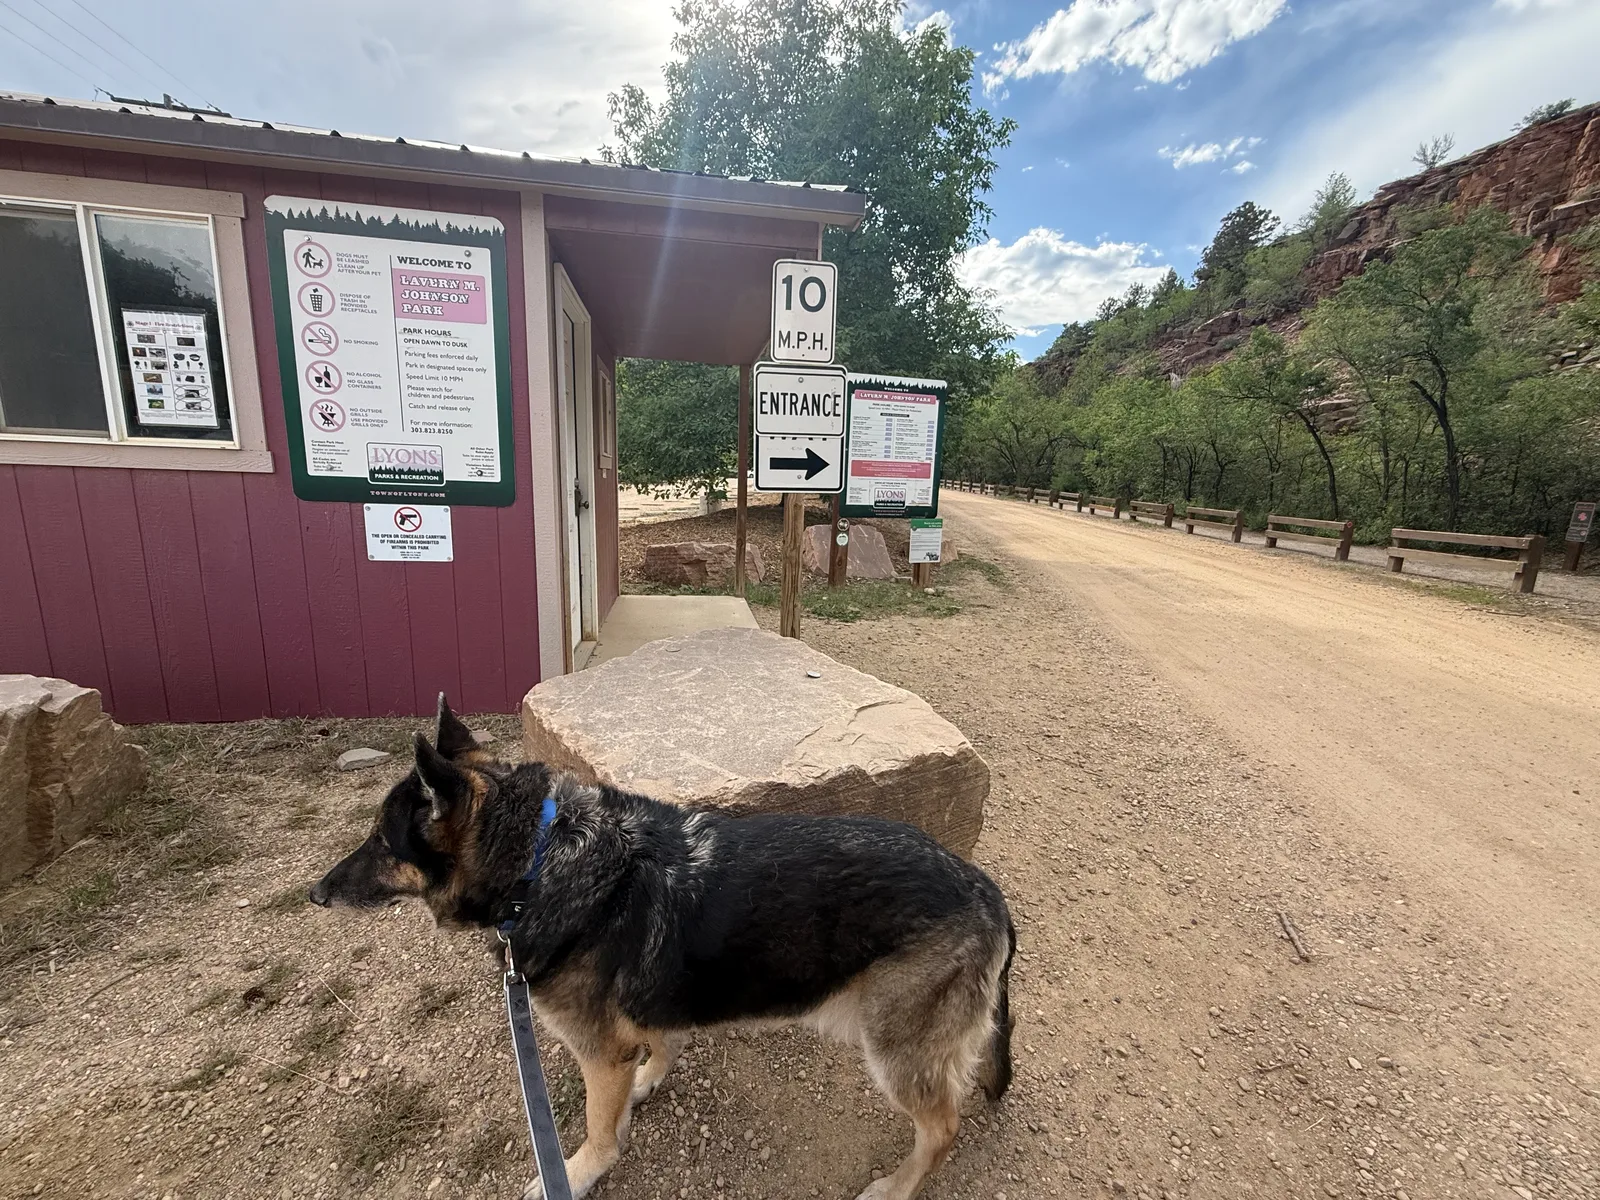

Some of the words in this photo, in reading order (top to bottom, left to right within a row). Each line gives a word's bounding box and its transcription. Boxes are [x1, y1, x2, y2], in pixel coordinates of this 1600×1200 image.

[397, 256, 454, 268] WELCOME
[456, 261, 472, 270] TO
[400, 275, 460, 289] LAVERN
[463, 280, 480, 291] M.
[401, 289, 469, 304] JOHNSON
[781, 274, 827, 313] 10
[402, 303, 444, 316] PARK
[778, 330, 828, 351] M.P.H.
[405, 350, 426, 359] Parking
[760, 391, 841, 418] ENTRANCE
[372, 448, 438, 464] LYONS
[877, 490, 904, 498] LYONS
